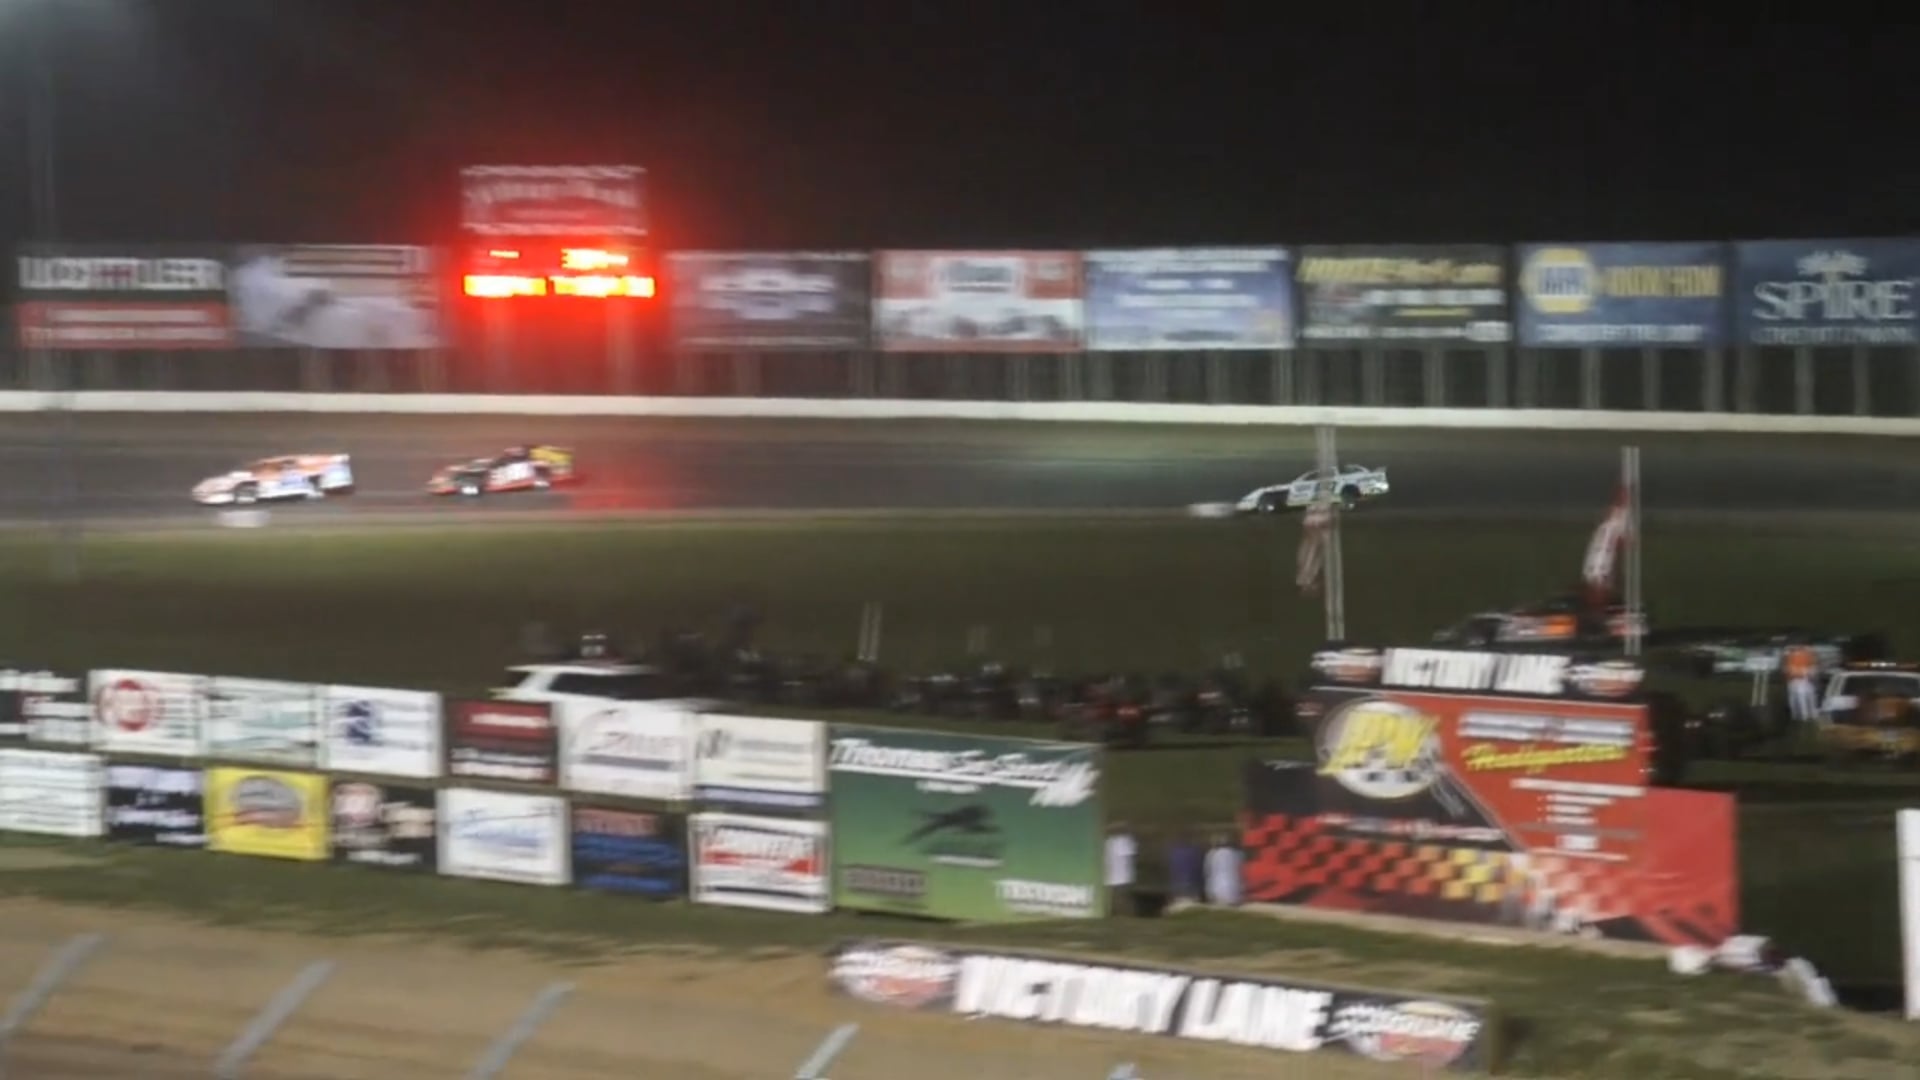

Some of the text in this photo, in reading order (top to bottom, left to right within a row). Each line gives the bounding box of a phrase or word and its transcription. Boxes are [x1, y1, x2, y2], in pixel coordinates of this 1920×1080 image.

[1753, 281, 1915, 320] SPIRE
[954, 955, 1189, 1033] VICTORY
[1173, 975, 1334, 1050] LANE
